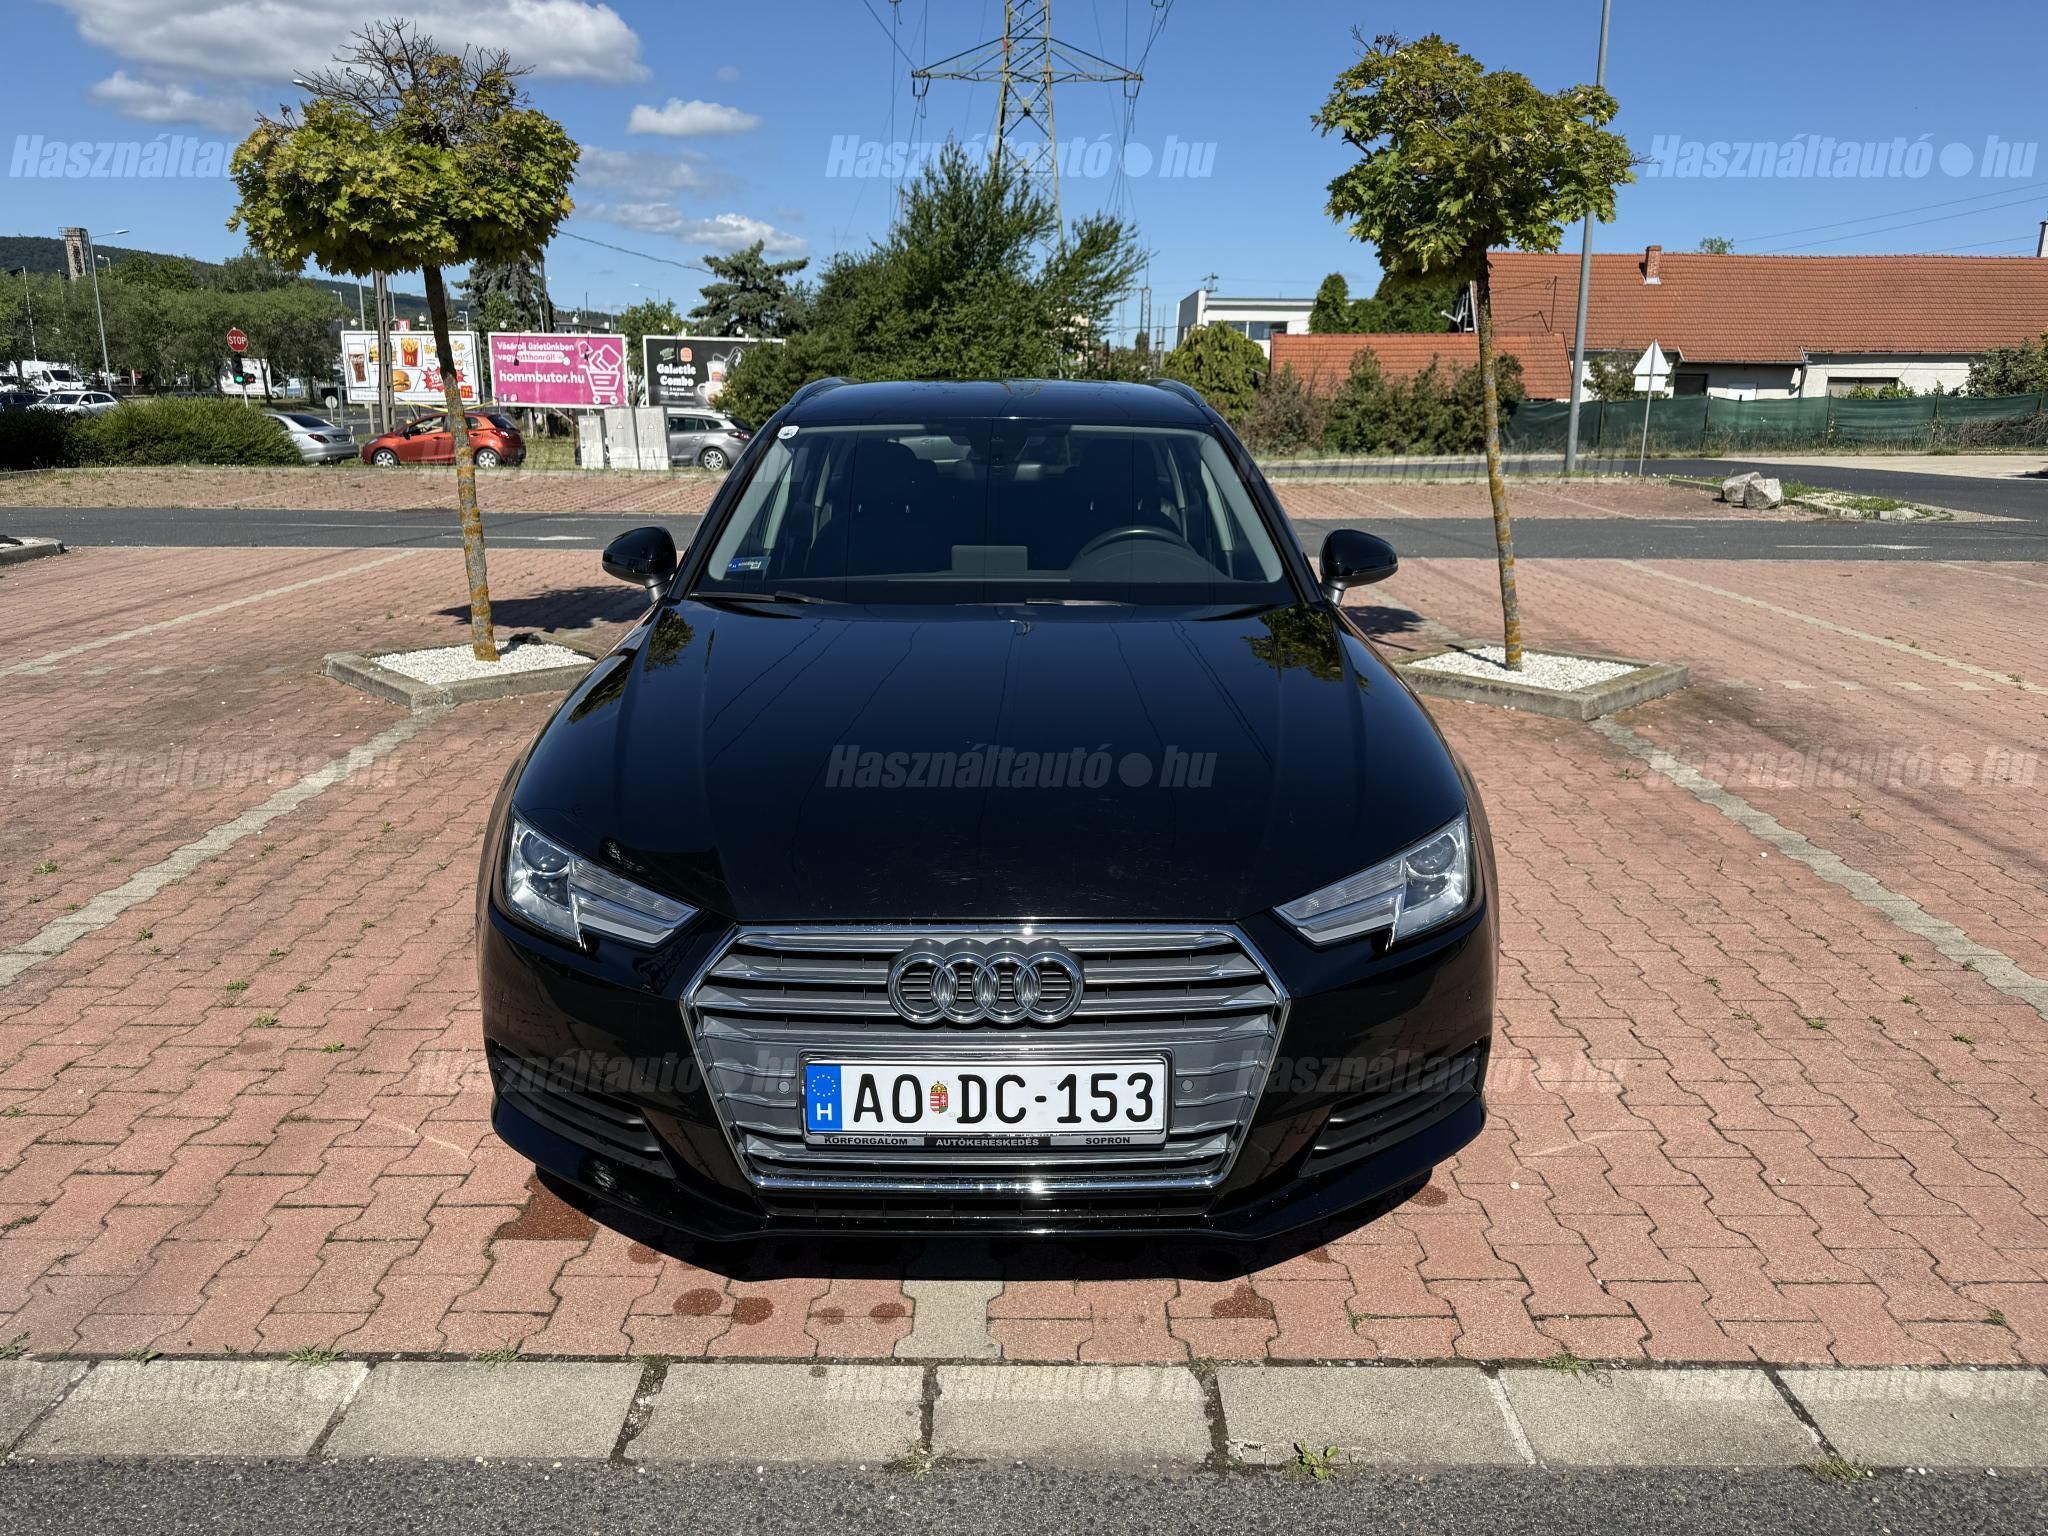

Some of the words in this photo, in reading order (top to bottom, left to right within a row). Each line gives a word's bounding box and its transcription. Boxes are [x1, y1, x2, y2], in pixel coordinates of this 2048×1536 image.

[228, 335, 246, 345] STOP
[528, 342, 575, 352] üzletünkben
[499, 370, 585, 384] hommbutor.hu
[660, 375, 694, 387] Combo
[816, 1102, 833, 1121] H
[935, 1138, 1040, 1146] AUTÓKERESKEDÉS
[1085, 1136, 1131, 1145] SOPRON
